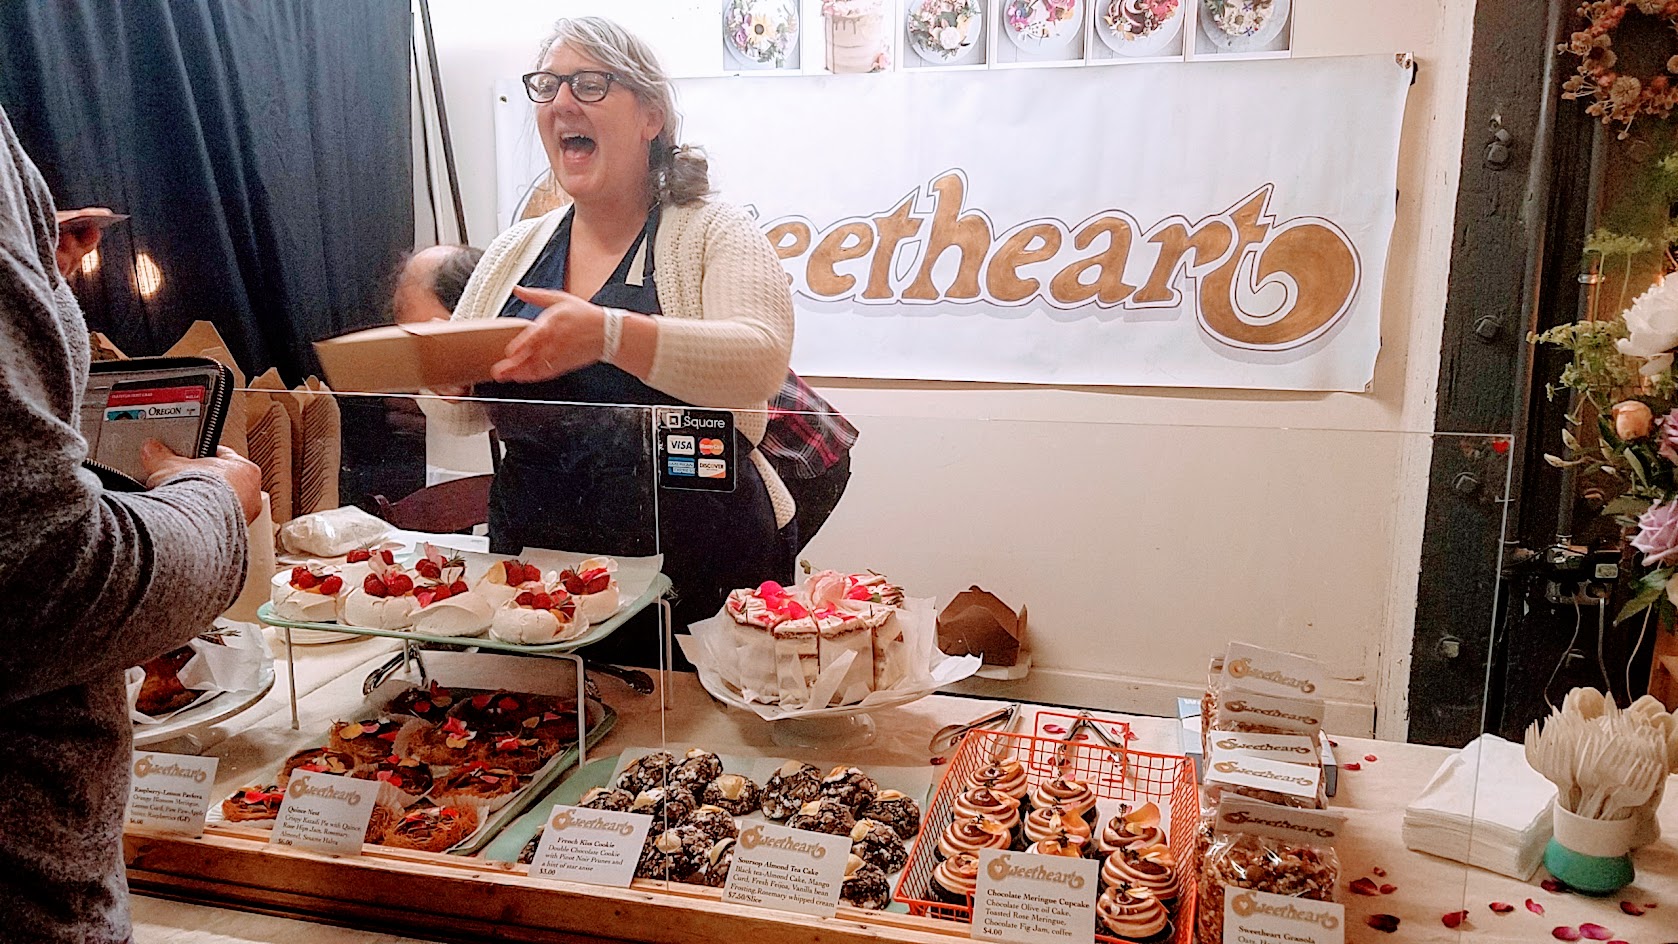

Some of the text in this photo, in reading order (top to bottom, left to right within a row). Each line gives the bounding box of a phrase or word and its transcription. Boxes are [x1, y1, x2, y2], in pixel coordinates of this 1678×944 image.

[748, 168, 1362, 350] eetheart
[149, 407, 181, 416] OREGON
[684, 416, 725, 429] Square
[671, 441, 692, 449] VISA
[1228, 657, 1315, 693] Sweetheart
[1225, 700, 1318, 724] Sweetheart
[1216, 739, 1310, 754] Sweetheart
[134, 755, 206, 782] Sweetheart
[1214, 762, 1313, 786] Sweetheart
[289, 776, 360, 805] Sweetheart
[552, 809, 634, 836] Sweetheart
[1222, 811, 1334, 838] Sweetheart
[570, 847, 598, 856] Chocolate
[740, 825, 826, 859] Sweetheart
[738, 857, 763, 868] Soursop
[764, 862, 789, 871] Almond
[987, 854, 1085, 889] Sweetheart
[733, 874, 750, 883] Curd,
[752, 877, 769, 886] Fresh
[792, 884, 812, 893] Vanilla
[735, 866, 752, 874] Black
[753, 869, 792, 880] tea-Almond
[809, 879, 830, 888] Mango
[789, 894, 815, 905] whipped
[816, 899, 834, 908] cream
[986, 899, 1019, 909] Chocolate
[1021, 903, 1039, 912] Olive
[1052, 908, 1071, 917] Cake,
[987, 889, 1090, 908] Chocolate Meringue Cupcake
[985, 908, 1066, 926] Toasted Rose Meringue,
[1232, 891, 1339, 929] Sweetheart
[983, 927, 1002, 936] $4.00
[984, 918, 1018, 929] Chocolate
[1020, 923, 1030, 932] Fig
[1052, 928, 1072, 937] coffee
[1238, 926, 1281, 940] Sweetheart
[1283, 934, 1315, 944] Granola
